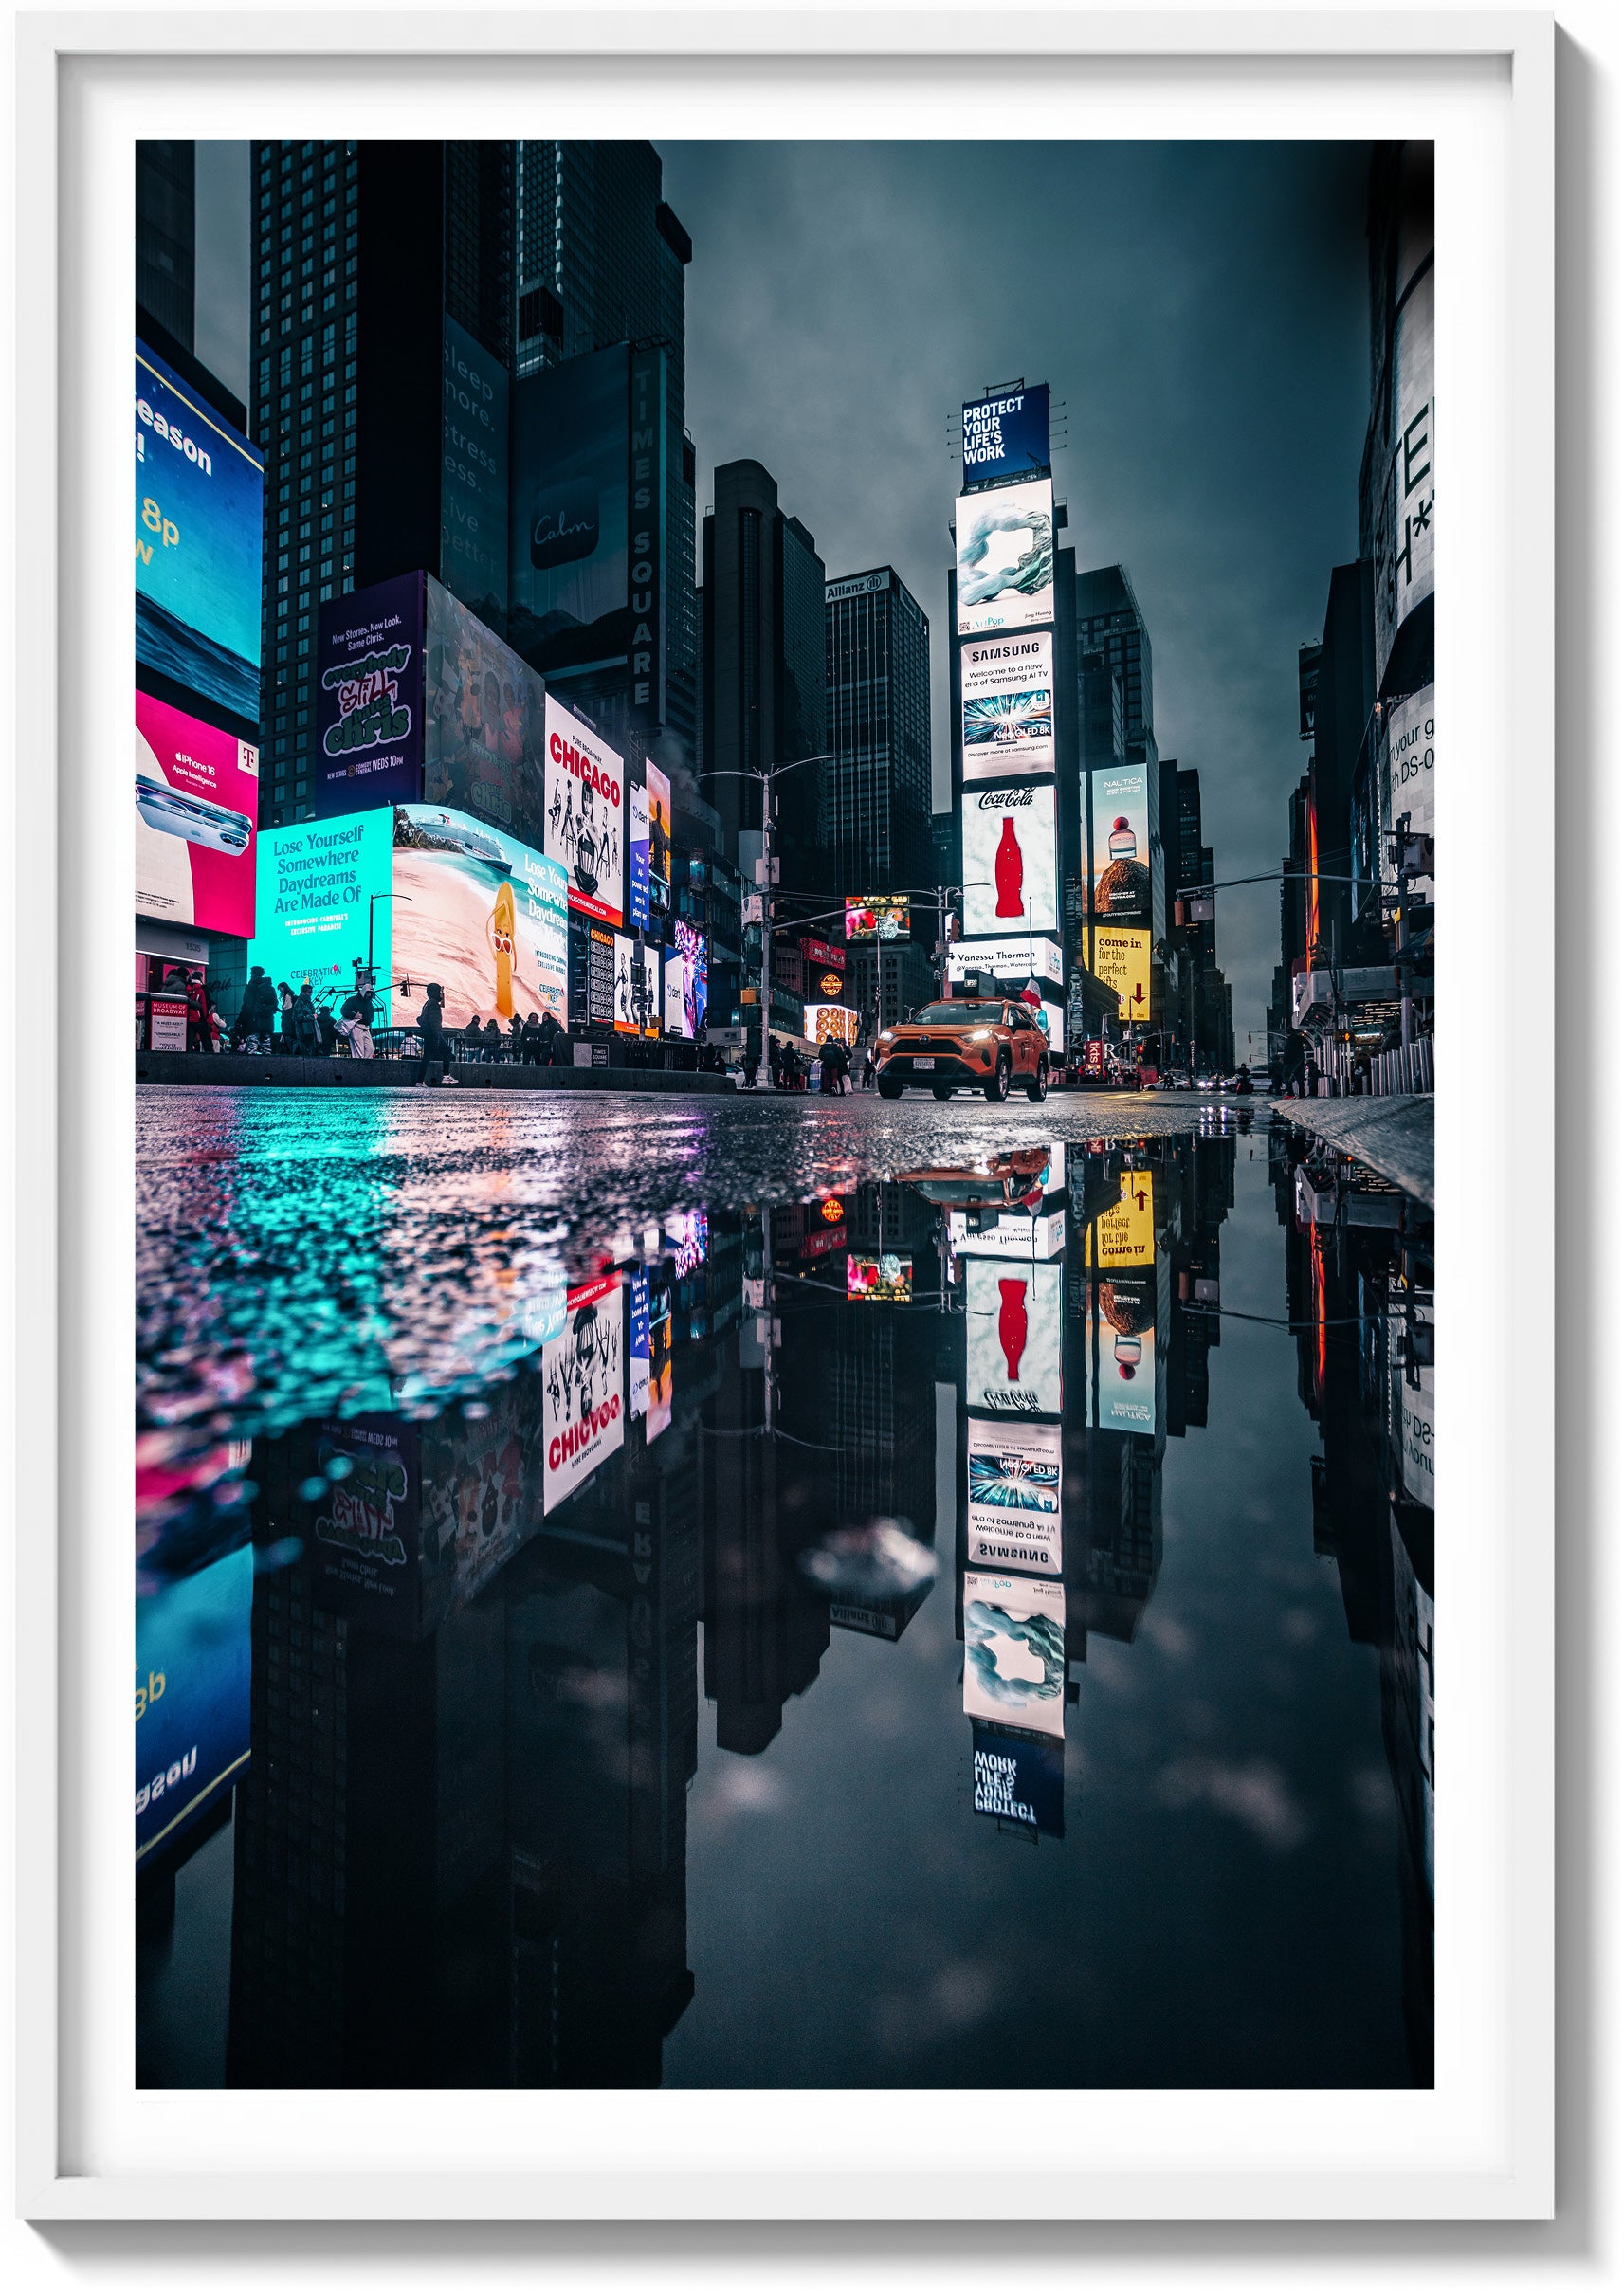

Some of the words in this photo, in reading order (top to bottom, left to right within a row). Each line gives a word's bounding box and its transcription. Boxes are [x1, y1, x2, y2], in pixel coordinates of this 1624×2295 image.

[963, 395, 1024, 424] PROTECT
[136, 397, 212, 477] eason
[962, 416, 1000, 436] YOUR
[632, 369, 653, 510] TIMES
[963, 430, 1002, 451] LIFE'S
[963, 443, 1005, 465] WORK
[141, 497, 180, 548] 8p
[443, 496, 478, 531] ive
[534, 510, 595, 545] Calm
[827, 583, 865, 599] Allianz
[631, 531, 653, 705] SQUARE
[332, 633, 345, 645] New
[345, 625, 369, 640] Stories.
[370, 621, 383, 632] New
[384, 614, 402, 628] Look.
[348, 639, 365, 651] Same
[366, 632, 385, 647] Chris.
[972, 642, 1040, 663] SAMSUNG
[323, 646, 410, 687] everybody
[969, 667, 1006, 678] Welcome
[980, 678, 988, 686] of
[990, 674, 1027, 685] Samsung
[325, 709, 410, 755] chris
[572, 735, 582, 747] PURE
[1015, 727, 1038, 738] QLED
[1039, 725, 1050, 736] 8K
[1396, 724, 1420, 761] your
[1012, 743, 1049, 752] samsung.com
[181, 754, 207, 773] iPhone
[207, 765, 215, 776] 16
[356, 767, 373, 776] CENTRAL
[372, 756, 389, 772] WEDS
[549, 732, 621, 808] CHICAGO
[173, 764, 189, 776] Apple
[189, 771, 217, 789] Intelligence
[1104, 776, 1143, 788] NAUTICA
[978, 787, 1036, 811] Coca-Cola
[273, 840, 303, 857] Lose
[306, 825, 364, 850] Yourself
[277, 848, 359, 875] Somewhere
[524, 853, 546, 881] Lose
[635, 852, 645, 865] Your
[279, 869, 356, 896] Daydreams
[274, 897, 298, 914] Are
[301, 890, 340, 910] Made
[342, 885, 362, 904] Of
[591, 928, 614, 947] CHICAGO
[1098, 938, 1129, 947] come
[1130, 938, 1142, 949] in
[958, 954, 994, 962] Vanessa
[996, 951, 1035, 959] Thorman
[1099, 947, 1110, 960] for
[1111, 948, 1125, 960] the
[290, 963, 342, 979] CELEBRATION
[1098, 963, 1127, 977] perfect
[1089, 1042, 1100, 1064] tkts
